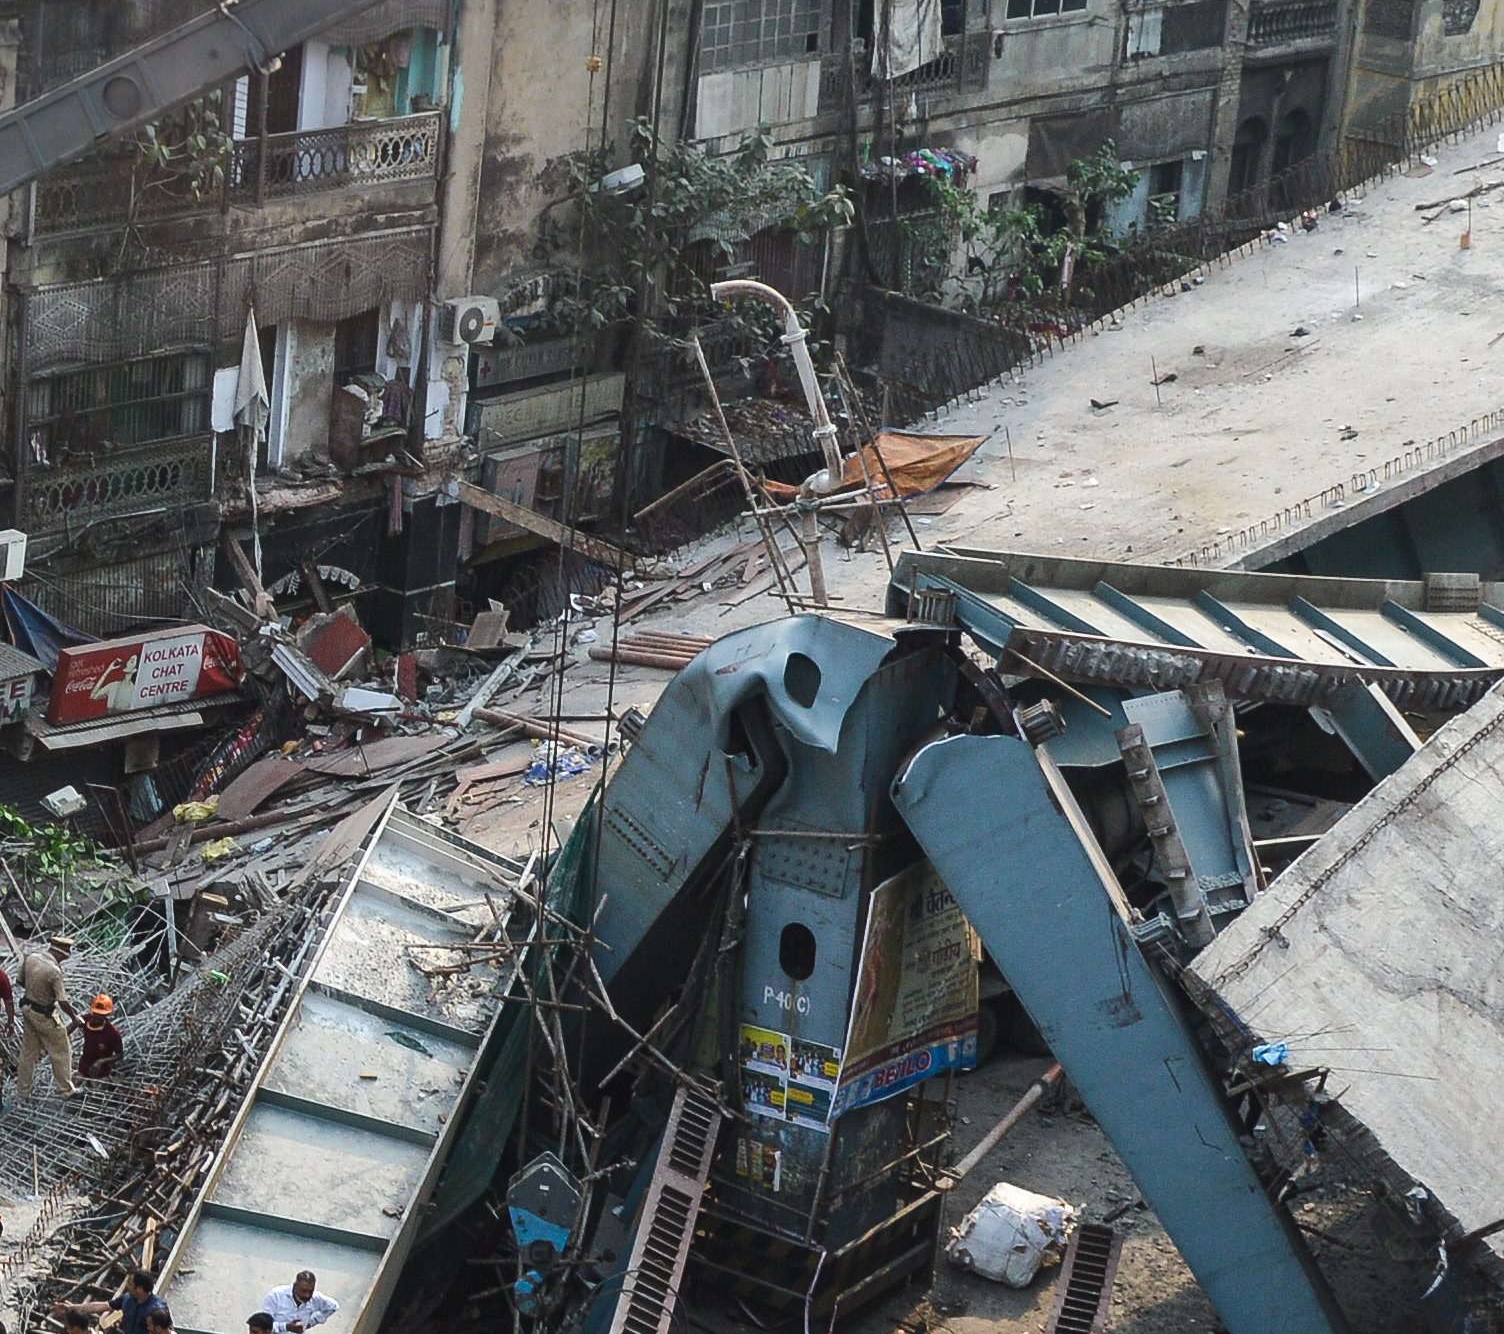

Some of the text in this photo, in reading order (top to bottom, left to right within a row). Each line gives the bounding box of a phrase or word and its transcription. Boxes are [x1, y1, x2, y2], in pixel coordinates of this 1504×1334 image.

[143, 644, 199, 664] KOLKATA
[151, 664, 184, 679] CHAT
[140, 680, 189, 698] CENTRE
